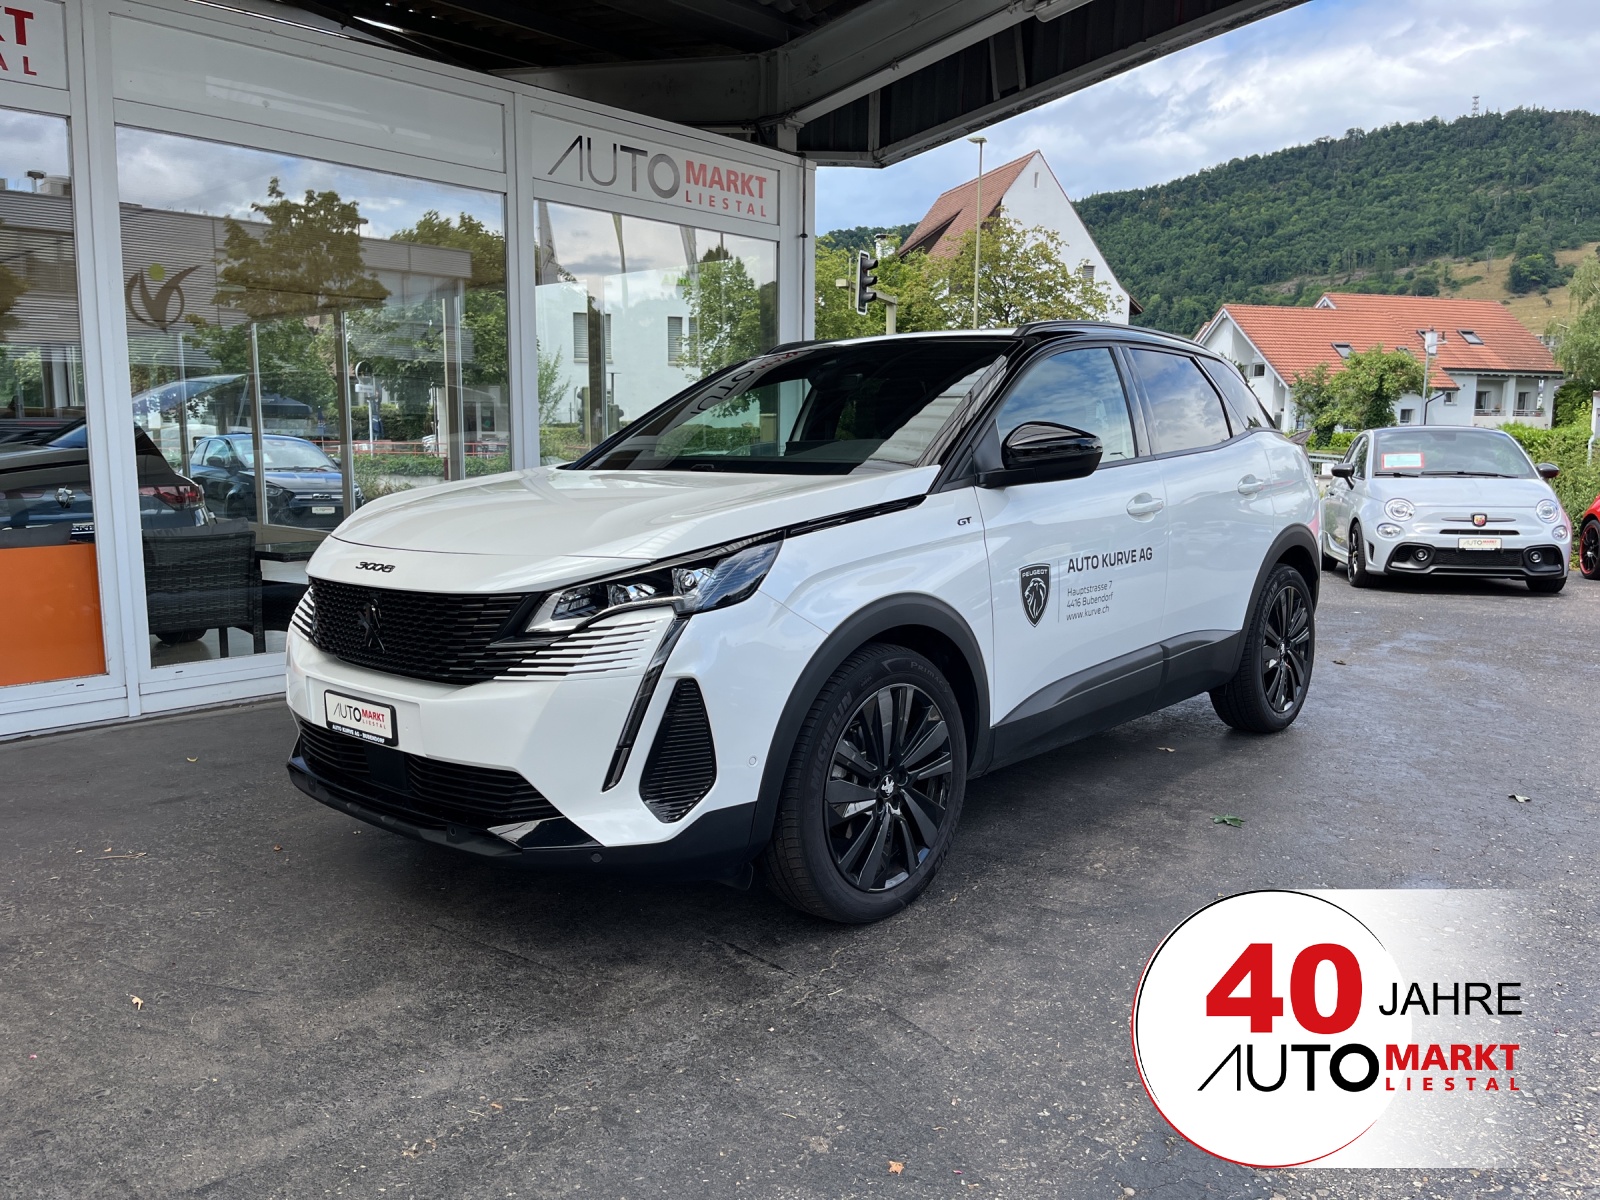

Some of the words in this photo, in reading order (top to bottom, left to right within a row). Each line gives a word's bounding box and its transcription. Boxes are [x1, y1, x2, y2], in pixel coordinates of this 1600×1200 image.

[0, 6, 34, 46] T
[685, 160, 767, 199] MARKT
[685, 190, 767, 217] LIESTAL
[957, 516, 972, 526] GT
[355, 561, 396, 573] 3008
[1067, 555, 1099, 574] AUTO
[1101, 549, 1137, 569] KURVE
[1139, 547, 1153, 562] AG
[1022, 568, 1048, 578] PEUGEOT
[1067, 583, 1108, 598] Hauptstrasse
[1108, 581, 1113, 590] 7
[1066, 599, 1082, 609] 4416
[1082, 592, 1114, 606] Bubendorf
[1066, 605, 1110, 621] www.kurve.ch
[333, 703, 361, 722] AUTO
[361, 709, 385, 722] MARKT
[362, 719, 386, 729] LIESTAL
[810, 691, 853, 790] MICHELIN
